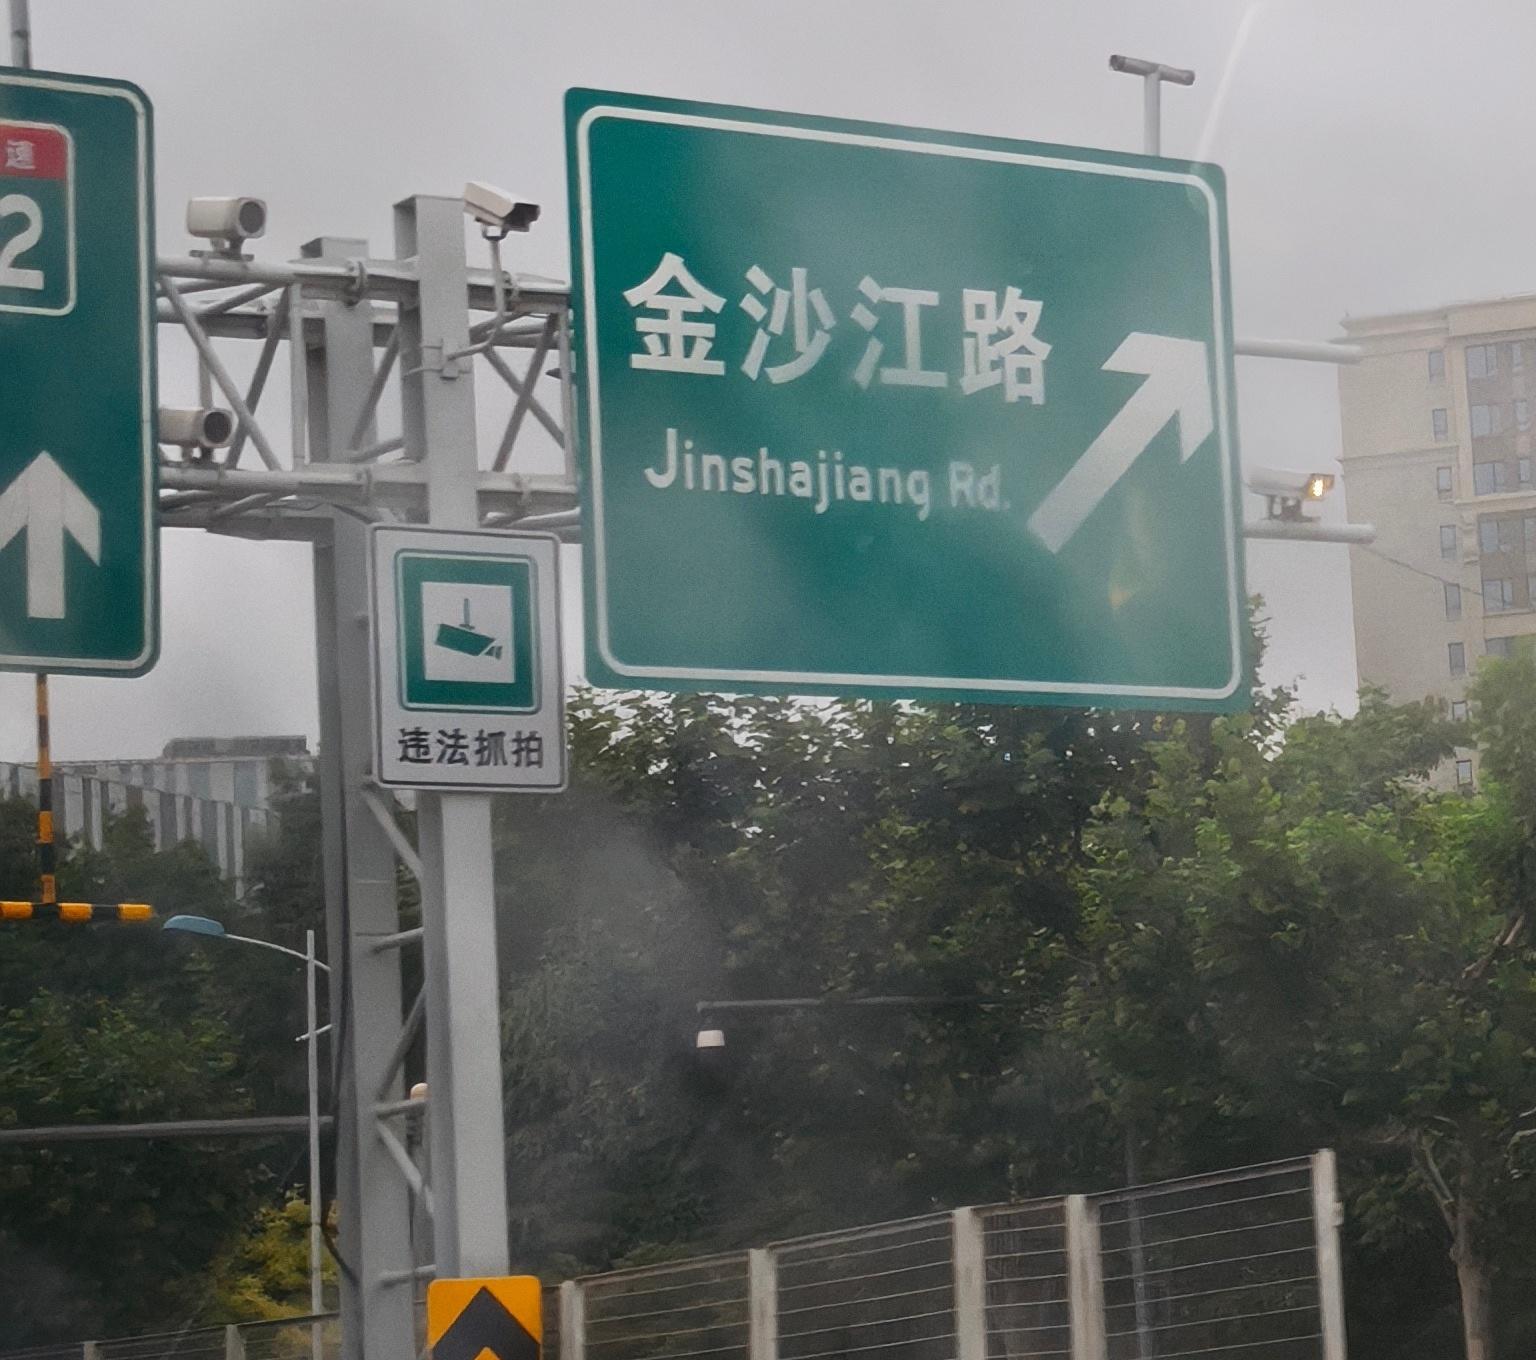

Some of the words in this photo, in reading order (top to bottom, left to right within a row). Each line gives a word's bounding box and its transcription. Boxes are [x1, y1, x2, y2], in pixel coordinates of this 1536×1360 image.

[622, 252, 1053, 406] 金沙江路
[644, 427, 930, 522] Jinshajiang
[397, 726, 544, 769] 违法抓拍
